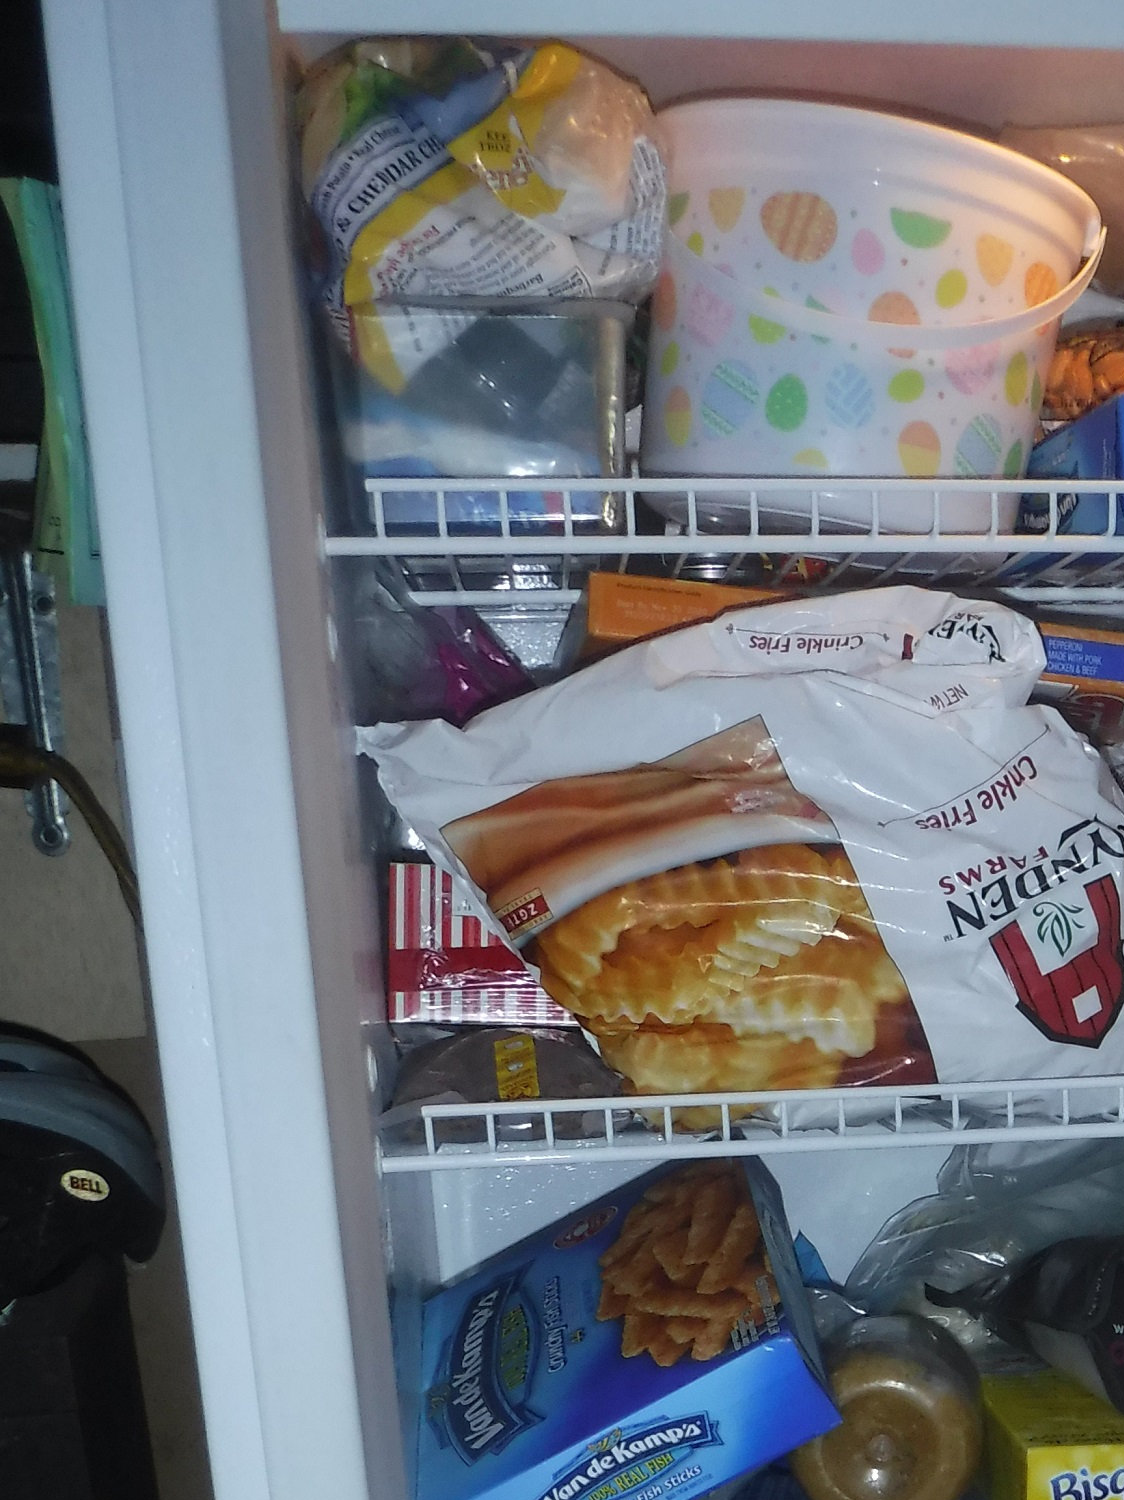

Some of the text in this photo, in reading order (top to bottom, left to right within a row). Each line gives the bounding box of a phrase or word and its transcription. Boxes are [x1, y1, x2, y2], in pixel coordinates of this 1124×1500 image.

[347, 148, 423, 215] CHEDDAR
[749, 632, 864, 656] Crinkle Fries
[1049, 640, 1082, 651] PEPPERONI
[1047, 661, 1075, 672] CHICKEN
[1082, 666, 1097, 675] BEEF
[1068, 654, 1083, 662] WITH
[944, 684, 969, 706] NET
[915, 800, 976, 830] Fries
[939, 845, 1047, 894] FARMS
[69, 1176, 103, 1194] BELL
[586, 1457, 616, 1478] de
[611, 1422, 702, 1464] Kamp's
[614, 1466, 648, 1492] REAL
[645, 1452, 674, 1474] FISH
[664, 1463, 702, 1490] Sticks
